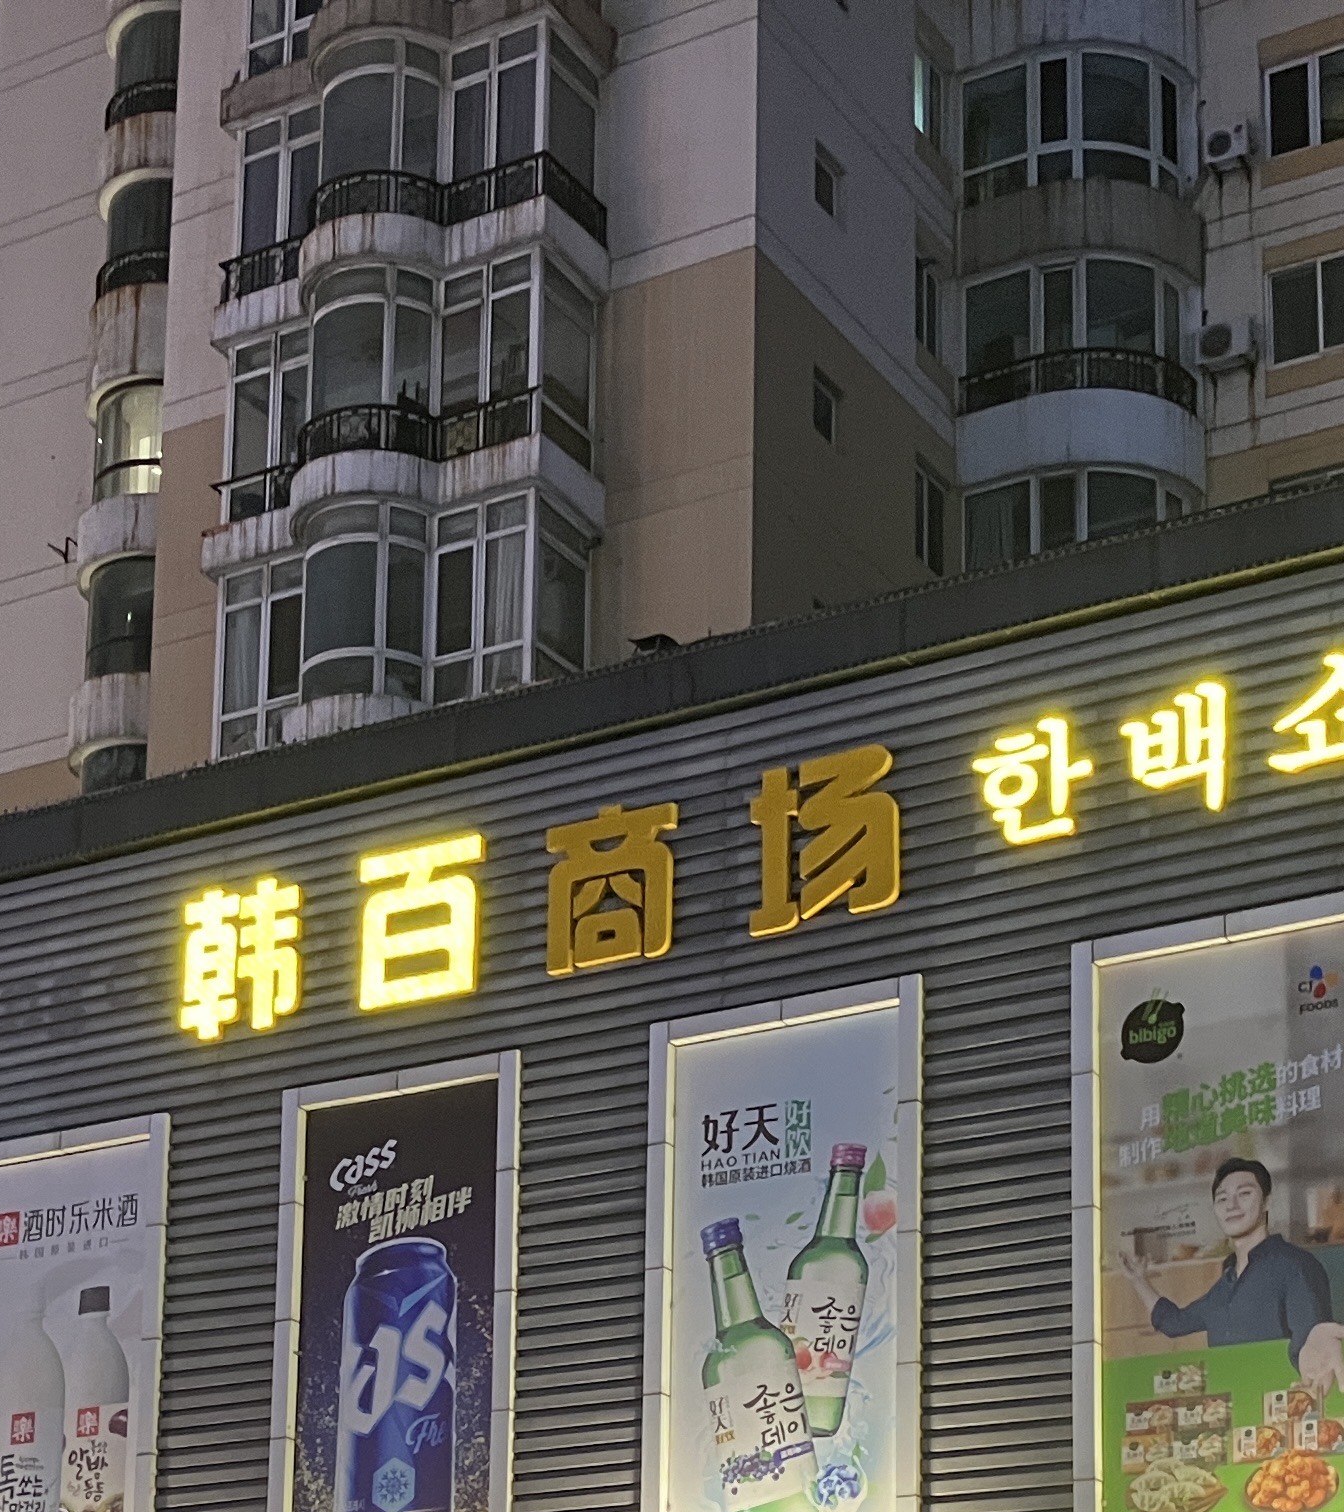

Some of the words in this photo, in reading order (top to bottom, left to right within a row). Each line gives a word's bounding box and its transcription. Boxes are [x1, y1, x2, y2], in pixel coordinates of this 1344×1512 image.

[179, 743, 902, 1042] 韩百商场
[1297, 980, 1314, 994] CJ
[1298, 998, 1339, 1015] FOODS
[1128, 1024, 1178, 1045] bibigo
[701, 1103, 780, 1157] 好天
[701, 1155, 738, 1172] HAO
[741, 1148, 781, 1165] TIAN
[701, 1157, 812, 1189] 韩国原装进口烧酒
[22, 1193, 139, 1244] 酒时乐米酒
[334, 1174, 435, 1231] 激情时刻
[367, 1186, 473, 1244] 凯狮相伴
[811, 1296, 861, 1334] 좋은
[813, 1334, 856, 1355] 데이
[742, 1382, 806, 1425] 좋은
[760, 1412, 809, 1447] 데이
